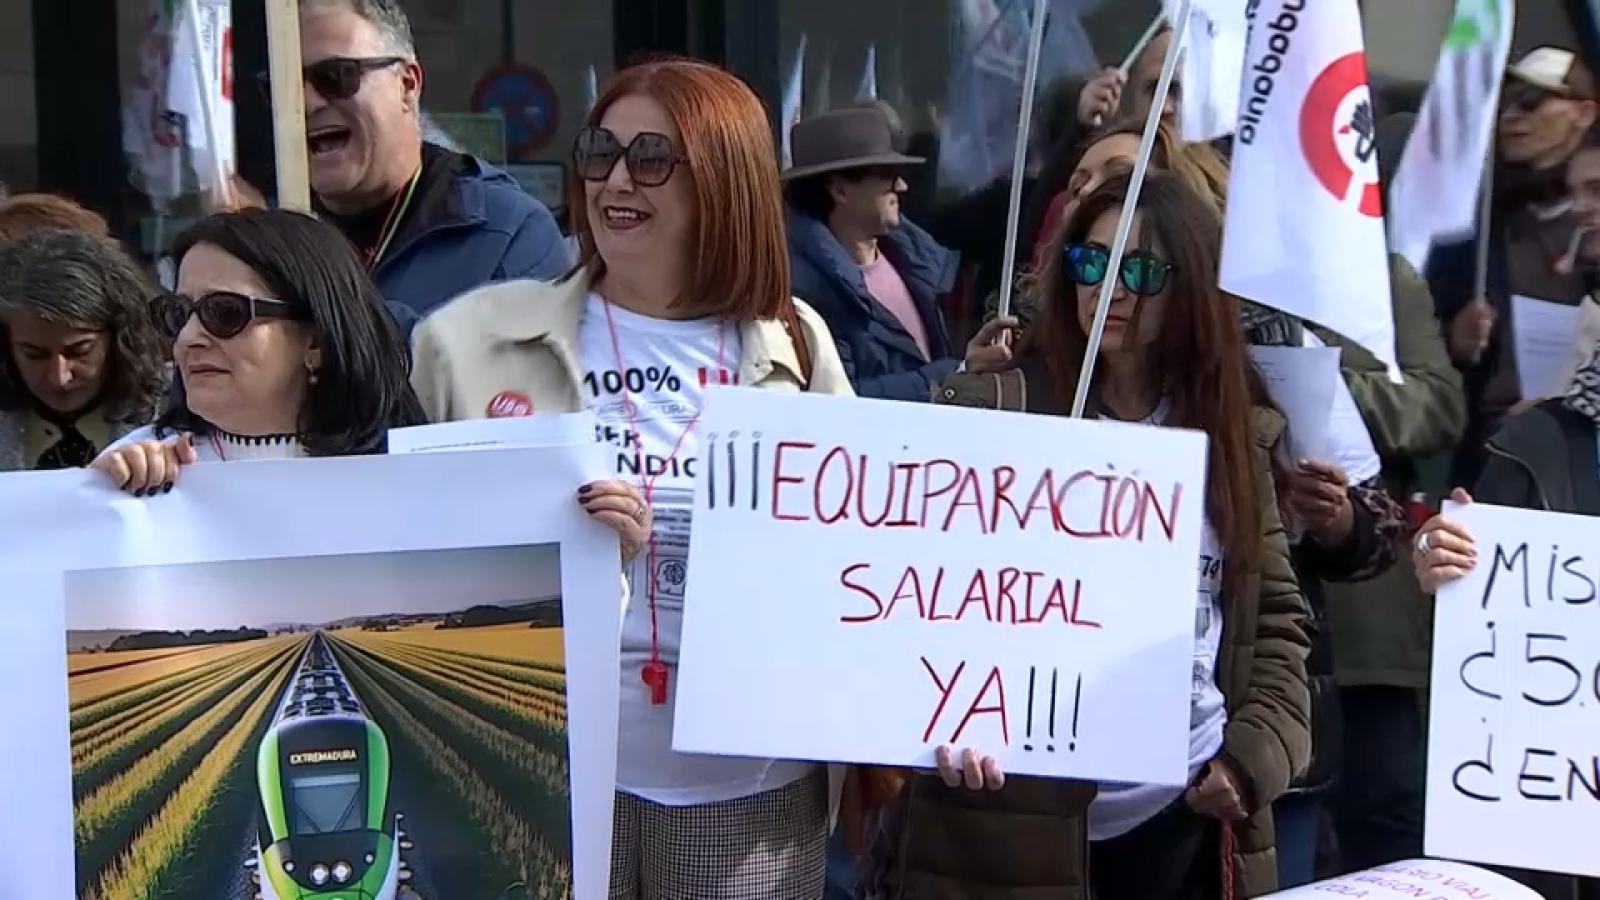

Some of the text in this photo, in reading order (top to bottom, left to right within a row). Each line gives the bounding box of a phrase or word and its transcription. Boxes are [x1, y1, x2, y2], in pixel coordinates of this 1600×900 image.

[583, 365, 681, 397] 100%
[839, 564, 1102, 628] SALARIAL
[1459, 620, 1600, 706] ¿5.
[920, 656, 1082, 752] YA!!!
[289, 748, 357, 765] EXTREMADURA
